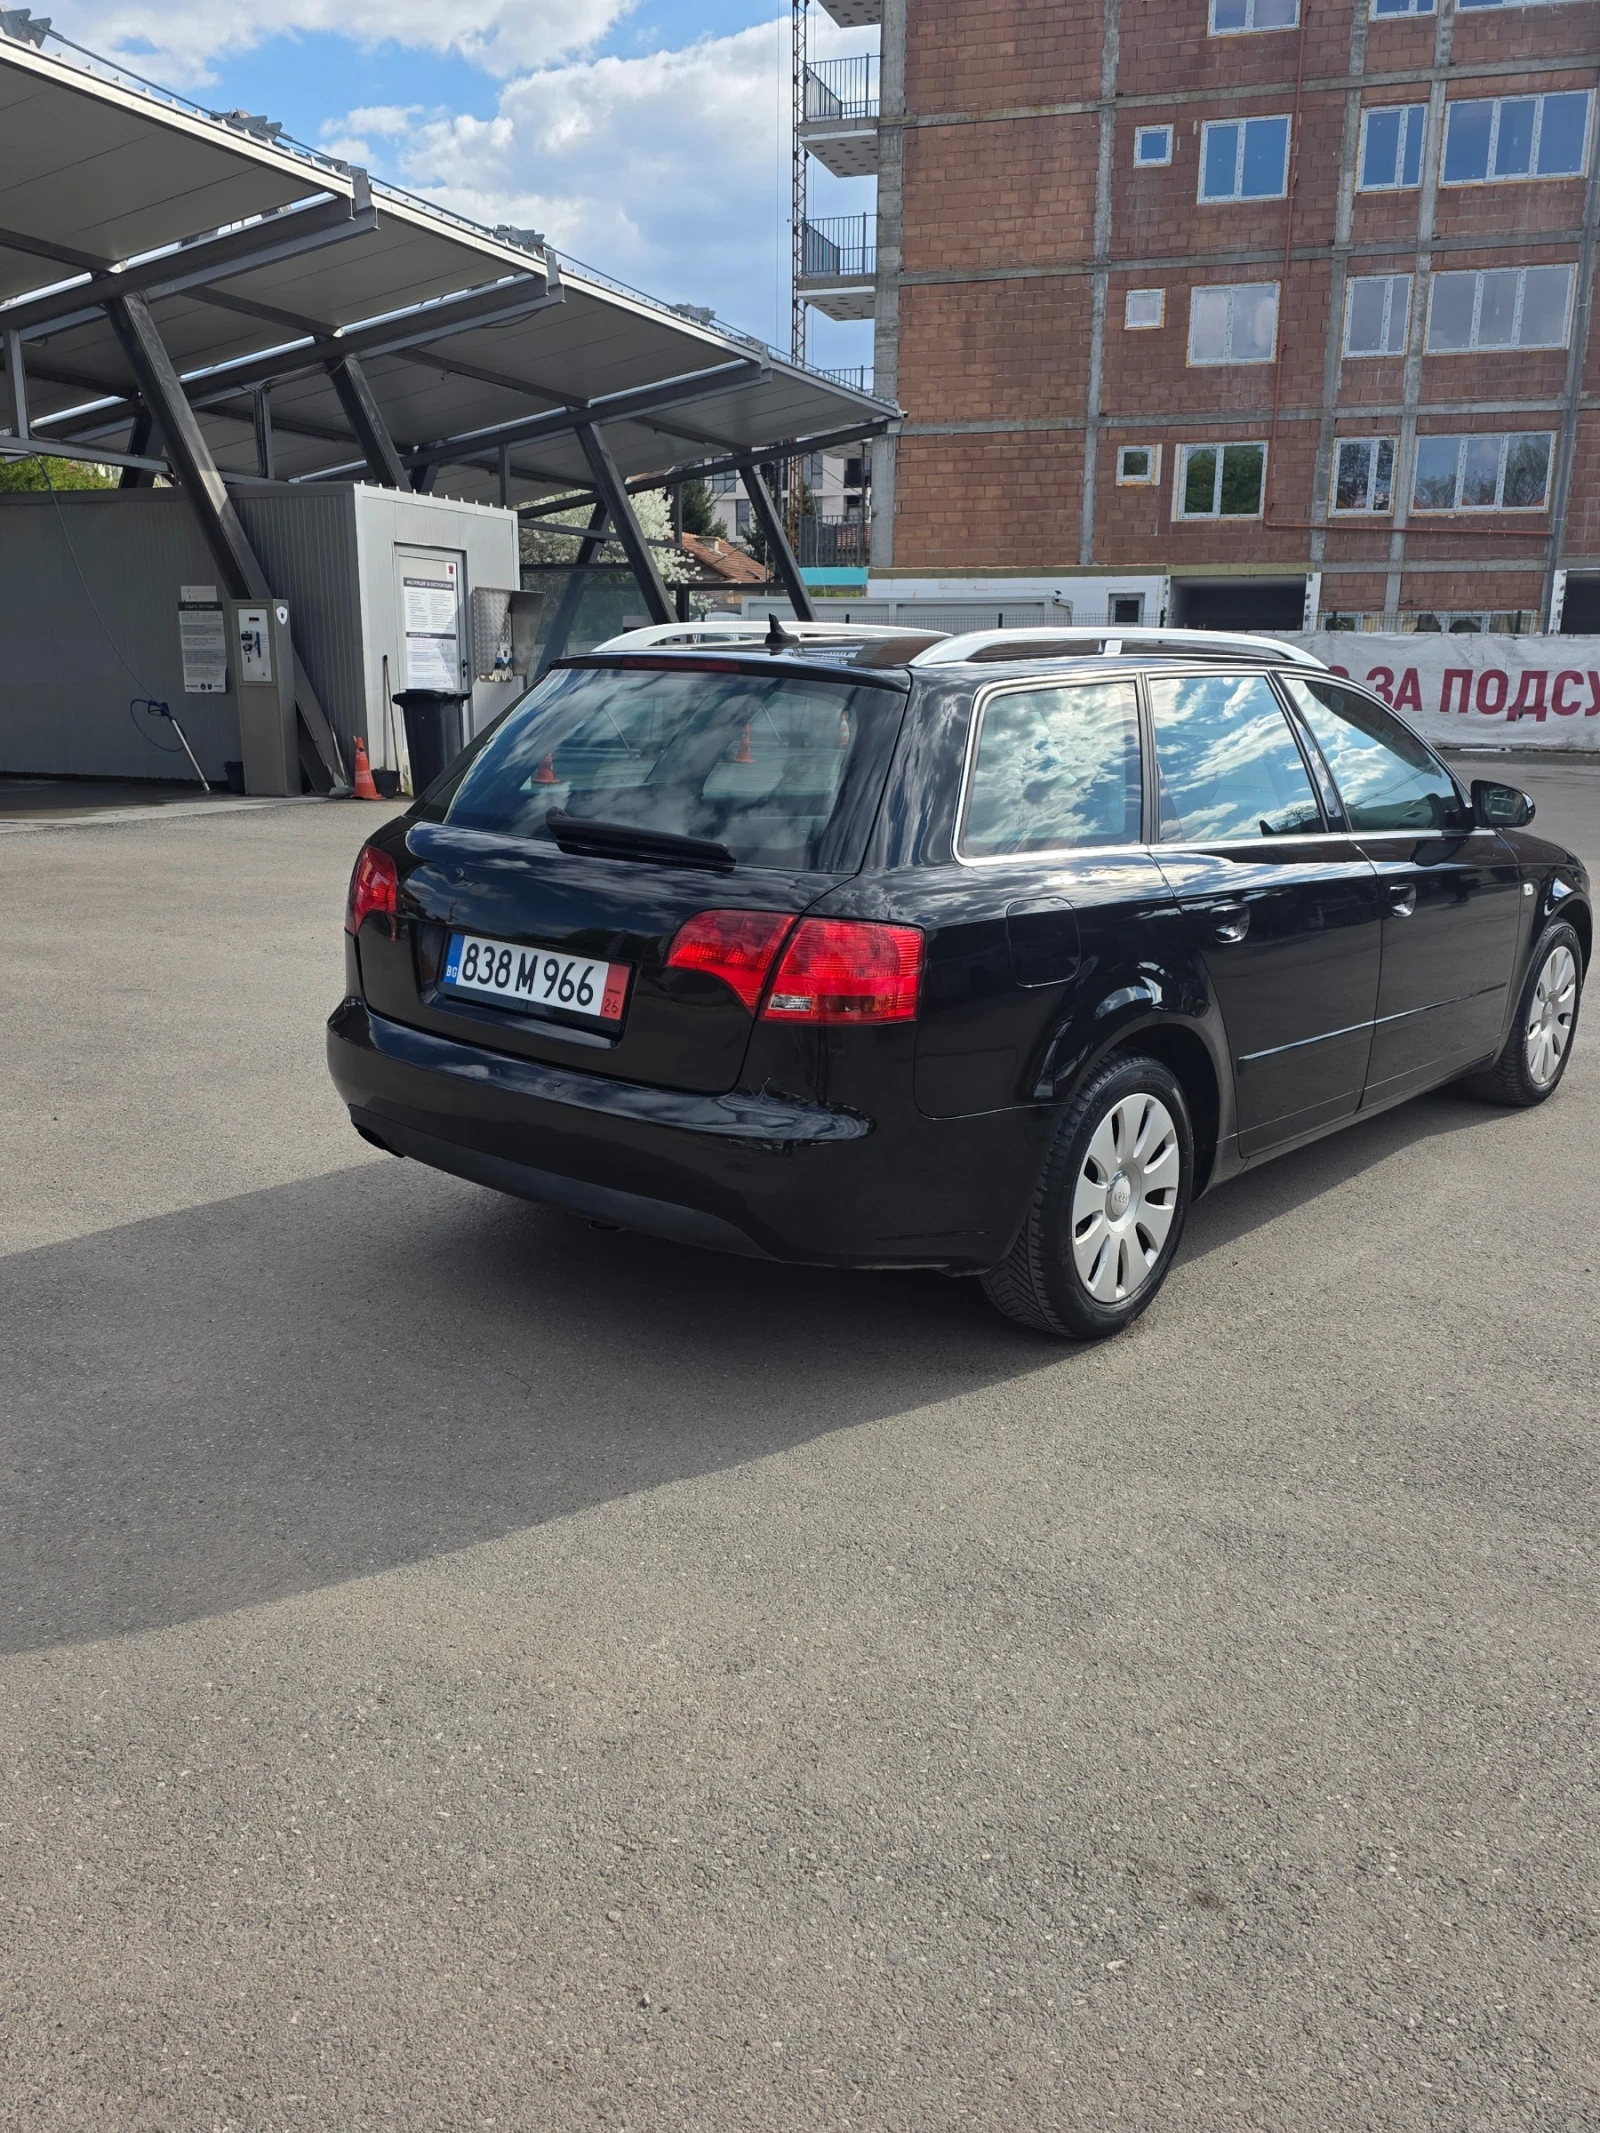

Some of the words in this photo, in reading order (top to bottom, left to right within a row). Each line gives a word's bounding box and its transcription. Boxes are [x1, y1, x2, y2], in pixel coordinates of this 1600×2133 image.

[1366, 666, 1423, 711] ЗА
[446, 964, 458, 978] BG
[604, 998, 618, 1014] 26
